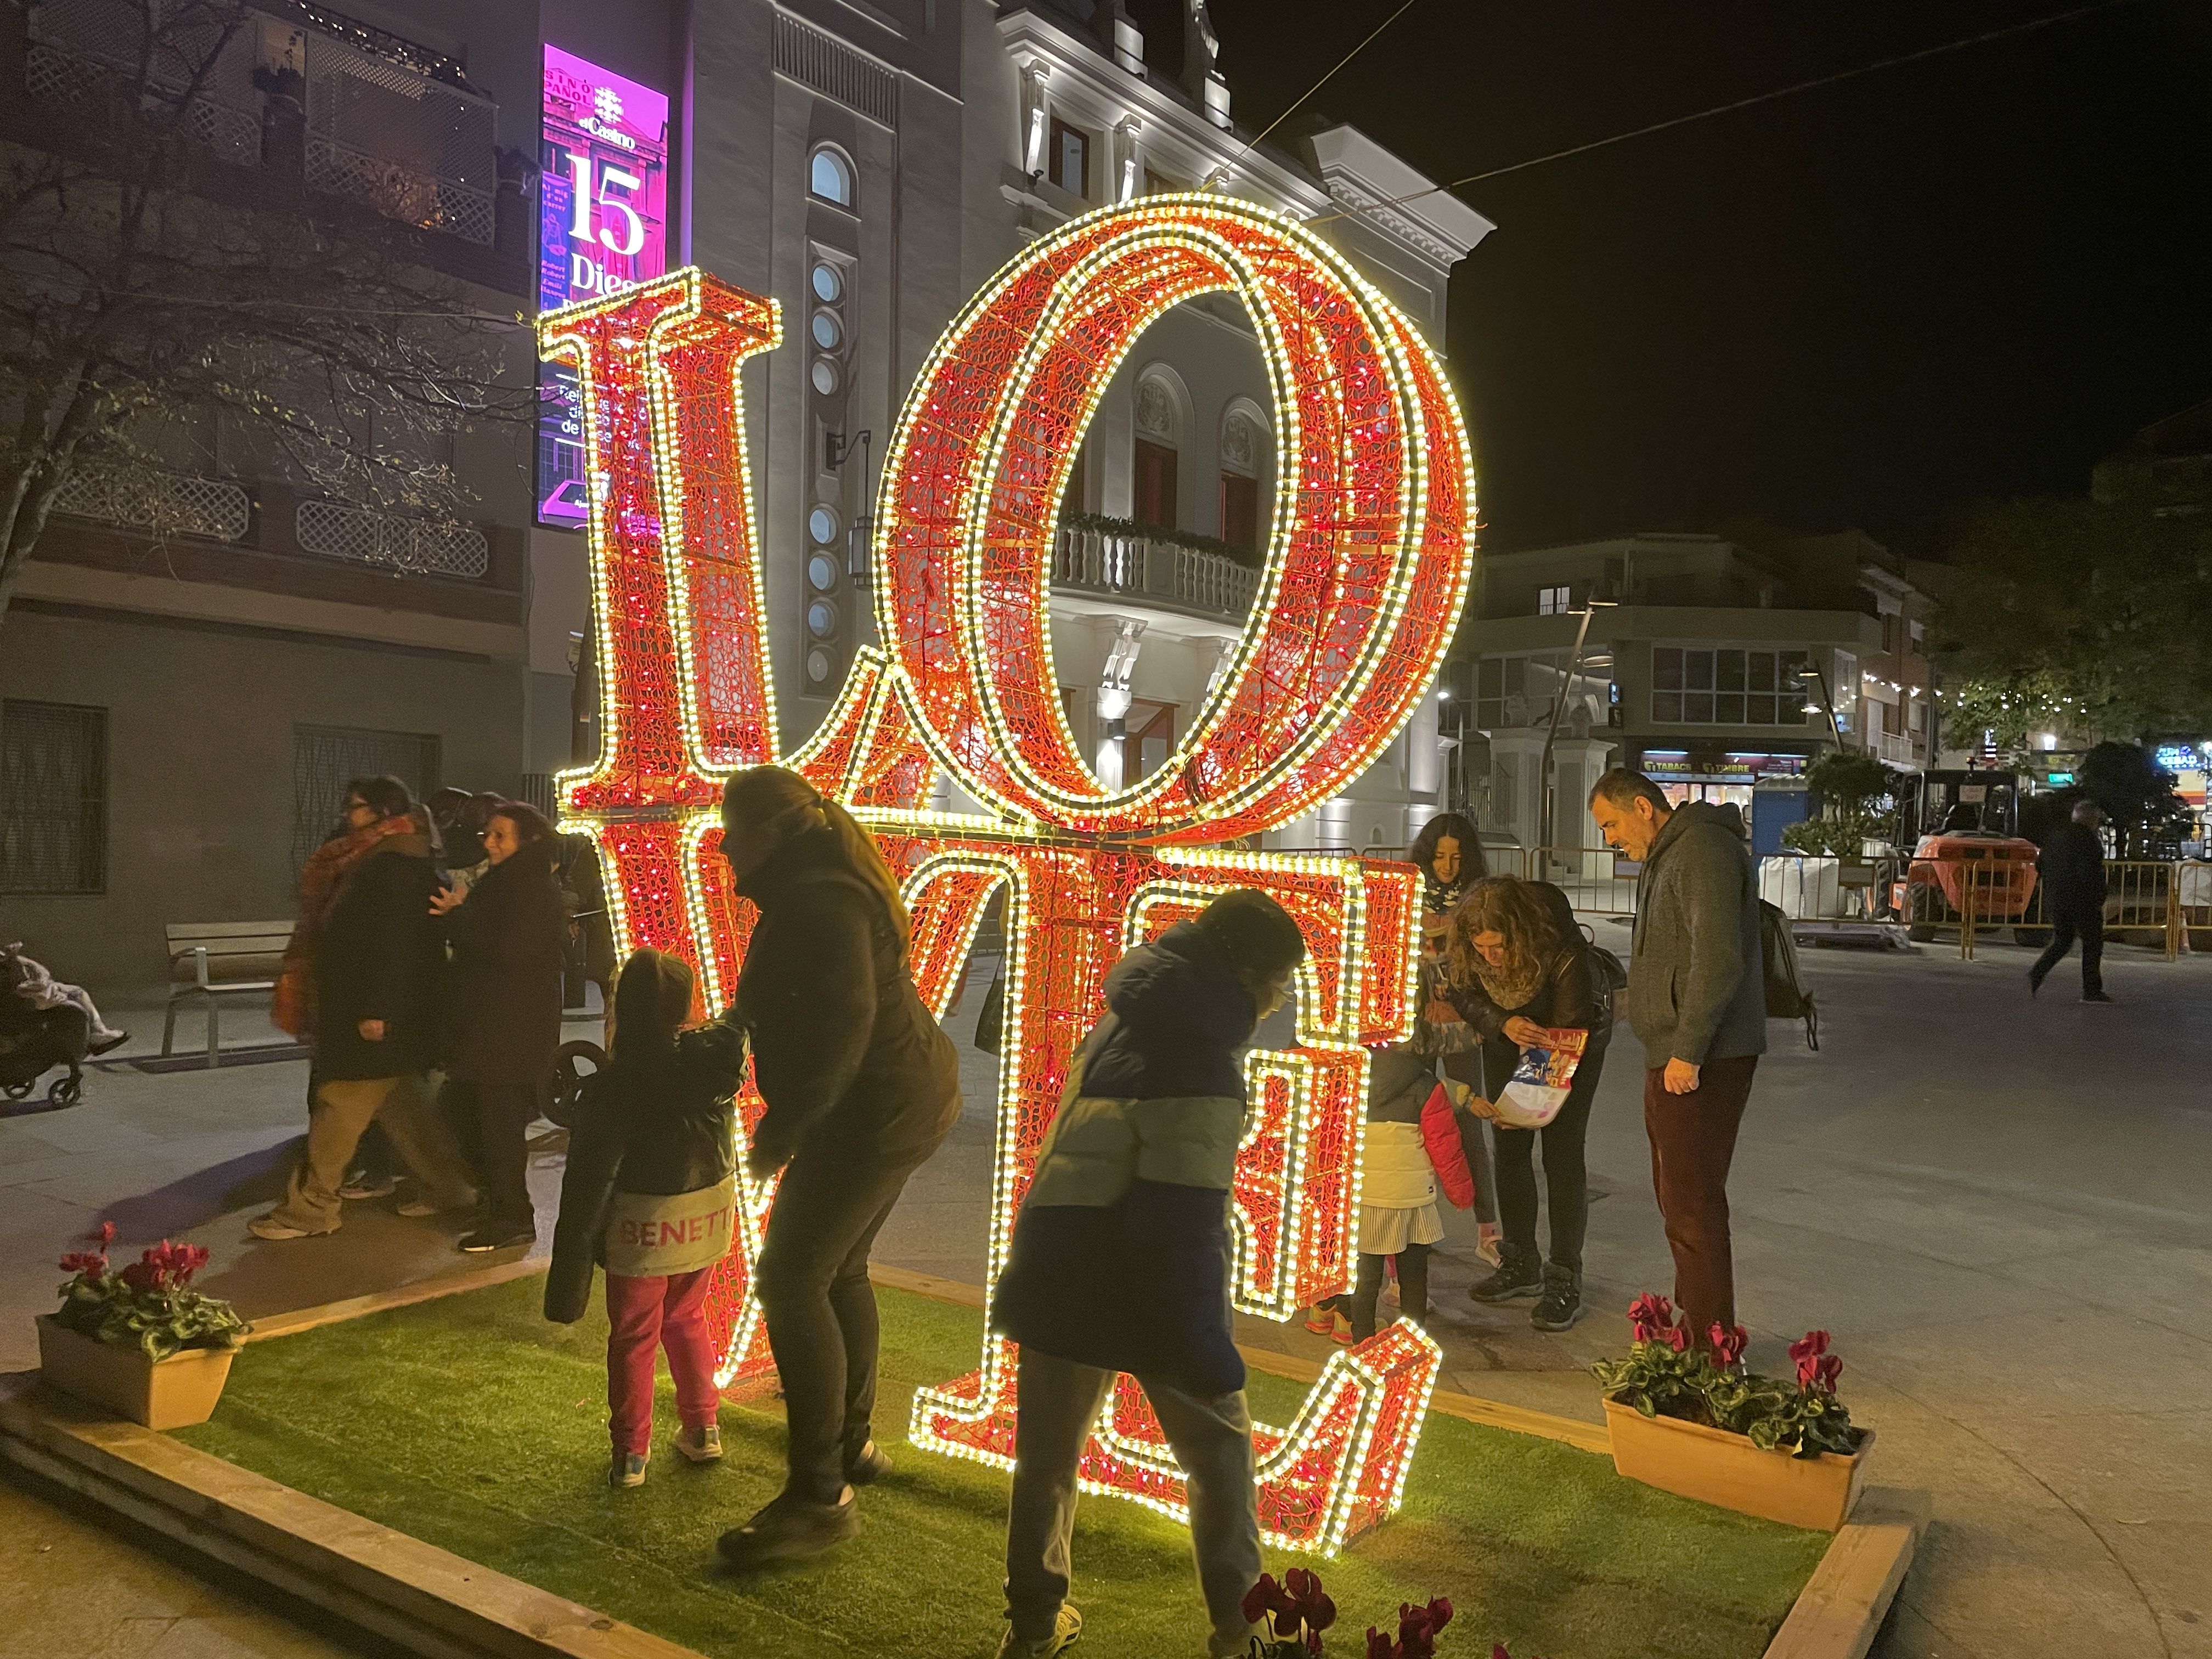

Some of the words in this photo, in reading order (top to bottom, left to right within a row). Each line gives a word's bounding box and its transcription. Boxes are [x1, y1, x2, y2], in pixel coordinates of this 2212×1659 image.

[588, 117, 636, 150] Casino
[565, 153, 644, 256] 15
[571, 252, 638, 295] Dies
[561, 419, 579, 435] de
[619, 1205, 733, 1247] BENETT
